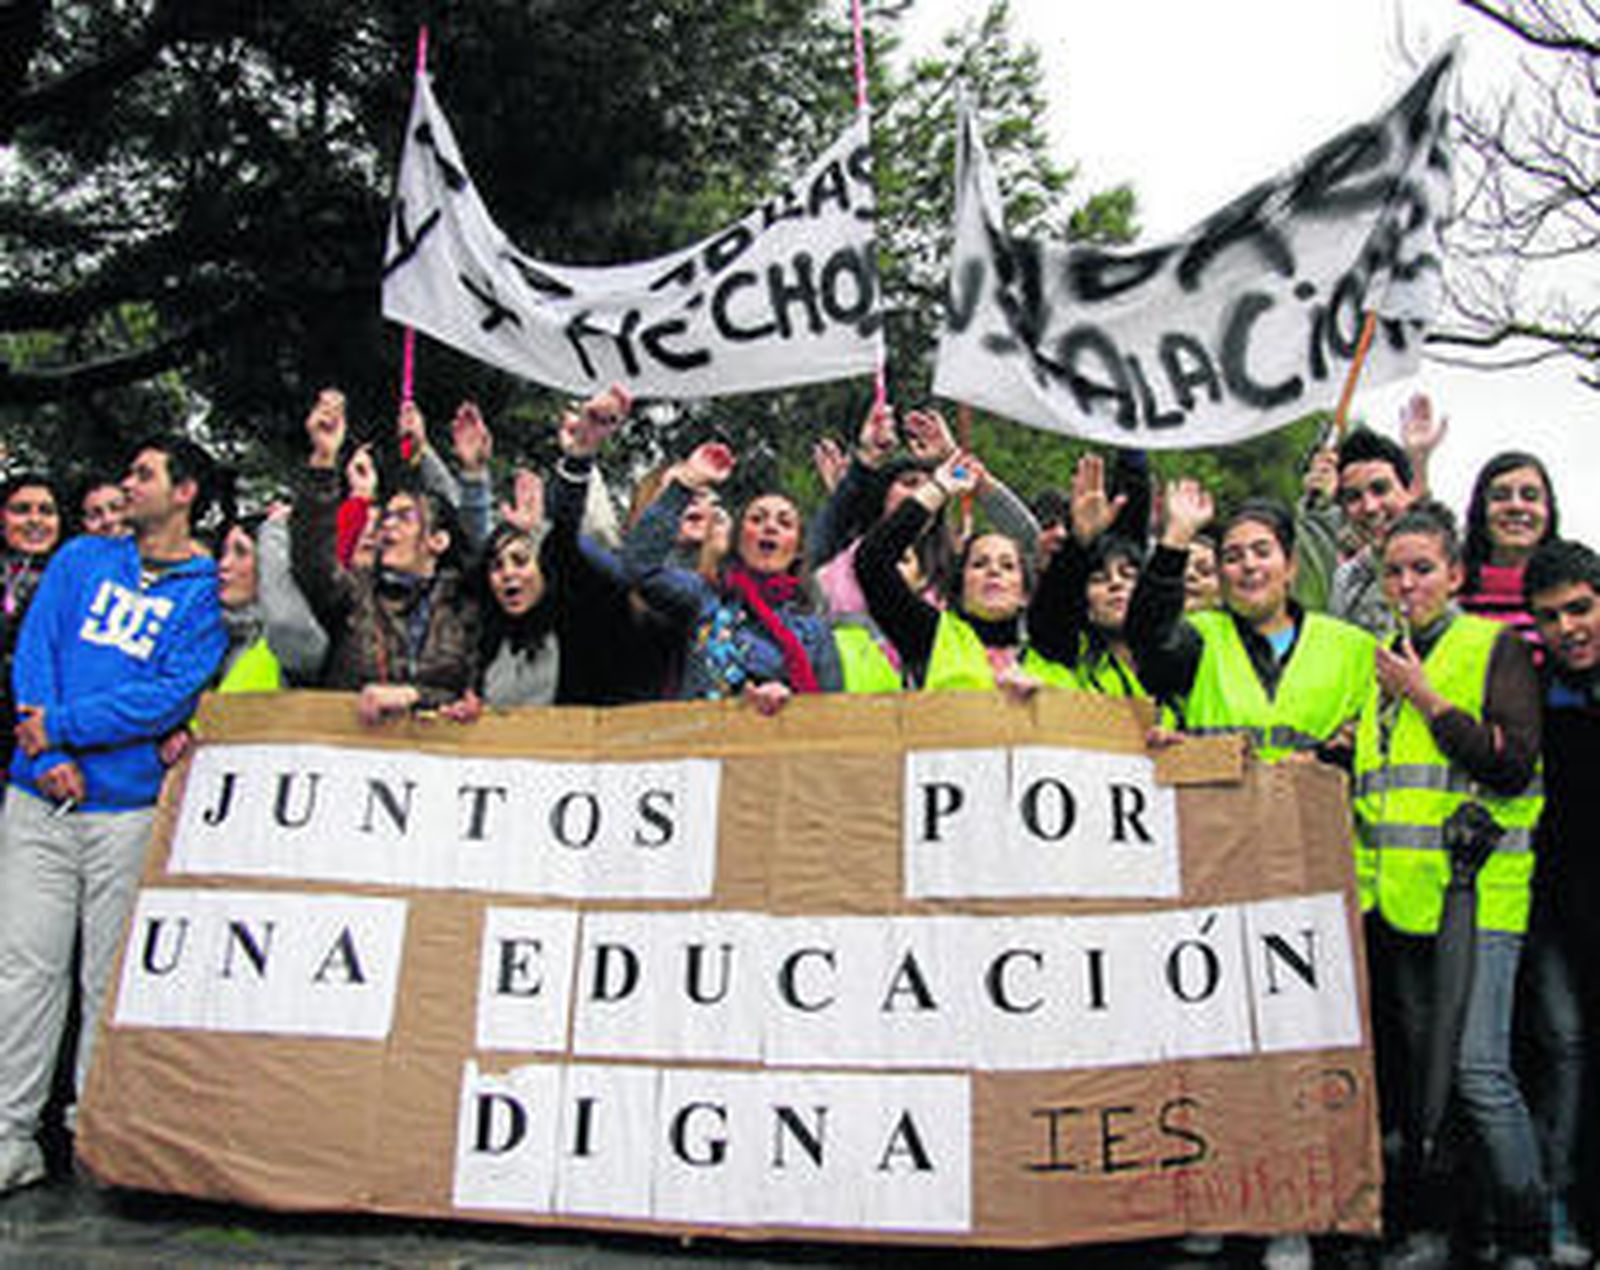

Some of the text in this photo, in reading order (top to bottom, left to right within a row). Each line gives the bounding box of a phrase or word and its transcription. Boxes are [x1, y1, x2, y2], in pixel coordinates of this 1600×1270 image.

[202, 772, 1154, 849] JUNTOS POR
[139, 914, 1320, 1014] UNA EDUCACIÓN
[472, 1092, 936, 1172] DIGNA
[1022, 1097, 1210, 1174] IES
